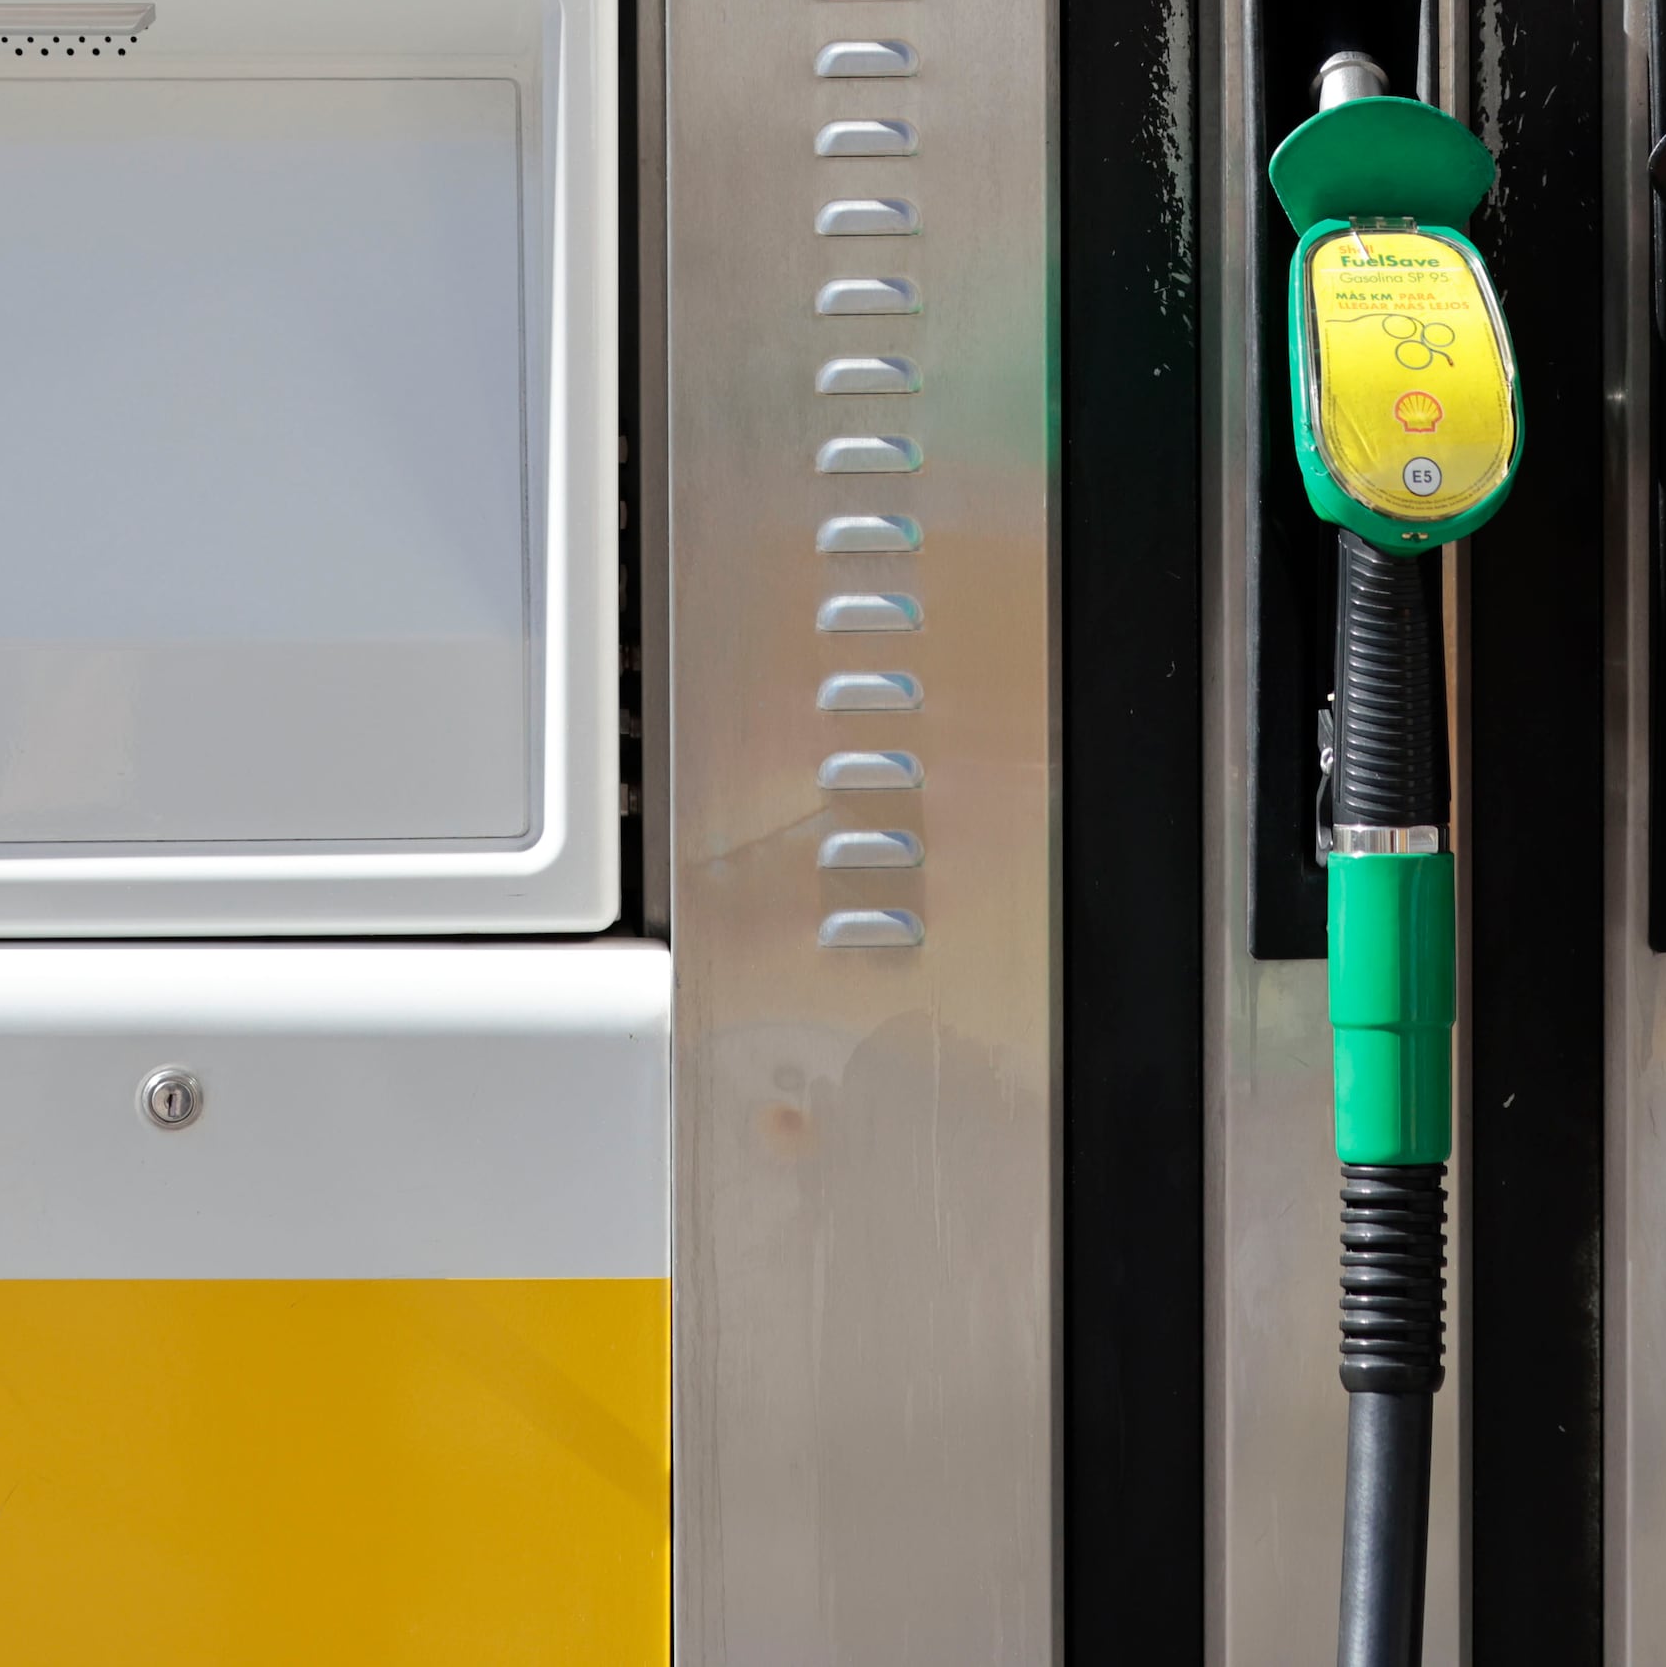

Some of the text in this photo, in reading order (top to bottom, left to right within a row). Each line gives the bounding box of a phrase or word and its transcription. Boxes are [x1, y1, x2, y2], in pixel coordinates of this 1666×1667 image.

[1338, 244, 1374, 254] Shll
[1341, 254, 1440, 268] FuelSave
[1339, 272, 1449, 283] Gasolina SP 95
[1371, 293, 1393, 301] KM
[1398, 292, 1436, 301] PARA
[1338, 302, 1389, 310] LLEGAR
[1428, 301, 1470, 310] LEJOS
[1412, 470, 1432, 484] E5
